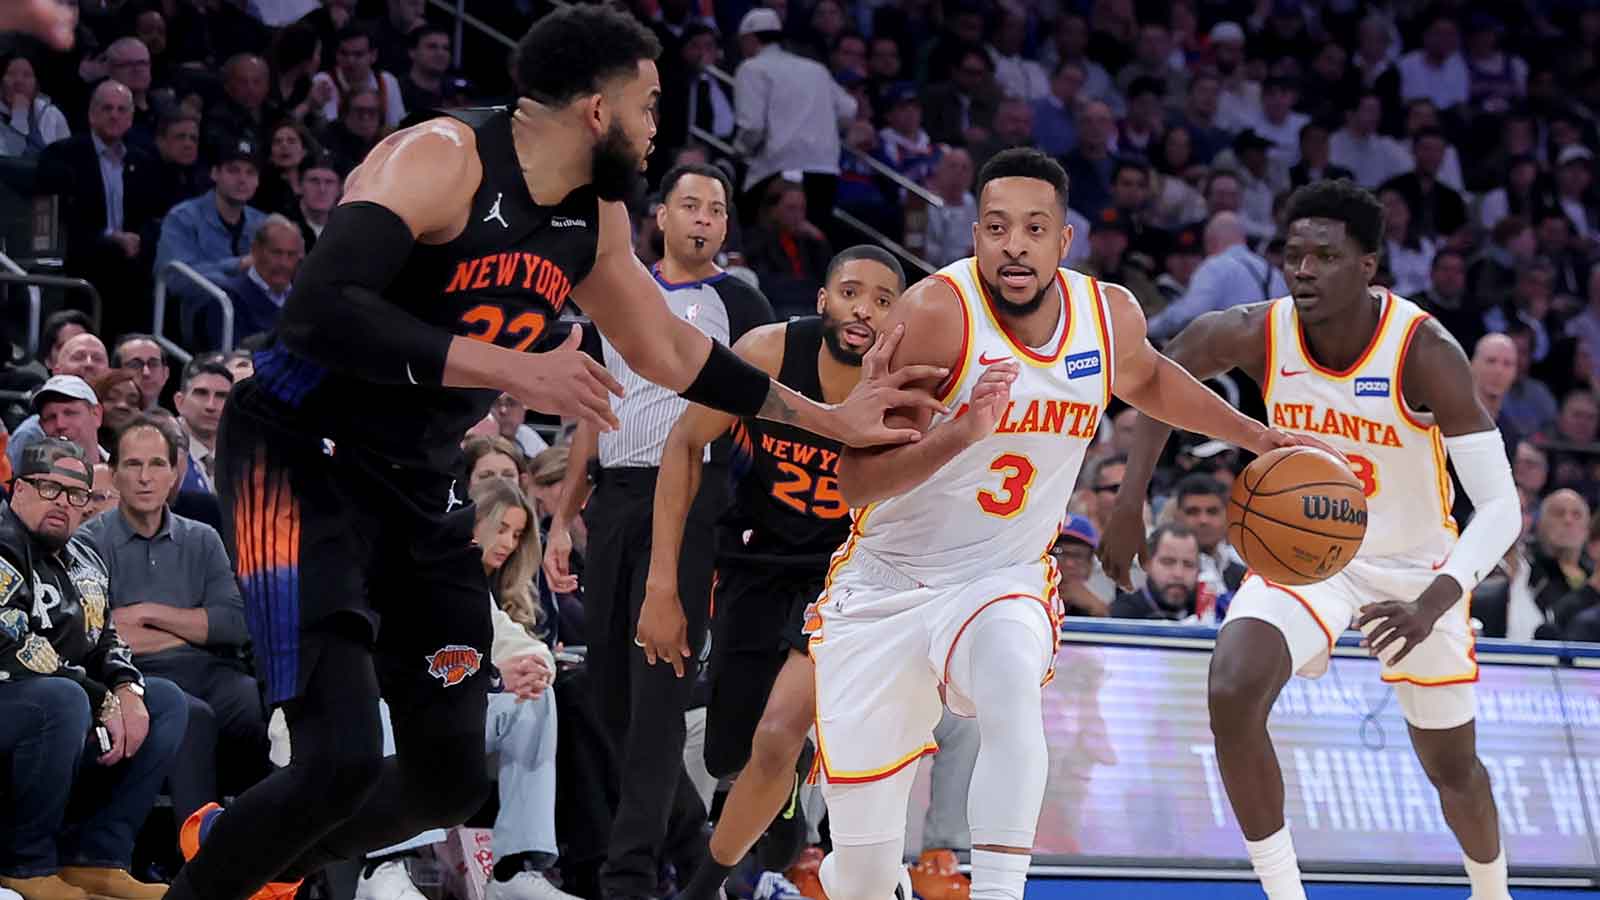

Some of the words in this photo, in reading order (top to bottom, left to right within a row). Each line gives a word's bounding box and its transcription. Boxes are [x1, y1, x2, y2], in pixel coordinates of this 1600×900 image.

[445, 252, 521, 293] NEW
[522, 253, 572, 314] YORK
[1067, 356, 1099, 374] paze
[1355, 380, 1388, 394] paze
[954, 400, 1099, 438] LANTA
[1272, 402, 1403, 448] ATLANTA
[761, 433, 818, 465] NEW
[771, 461, 849, 519] 25
[976, 452, 1038, 520] 3
[1293, 746, 1542, 836] MINIARE
